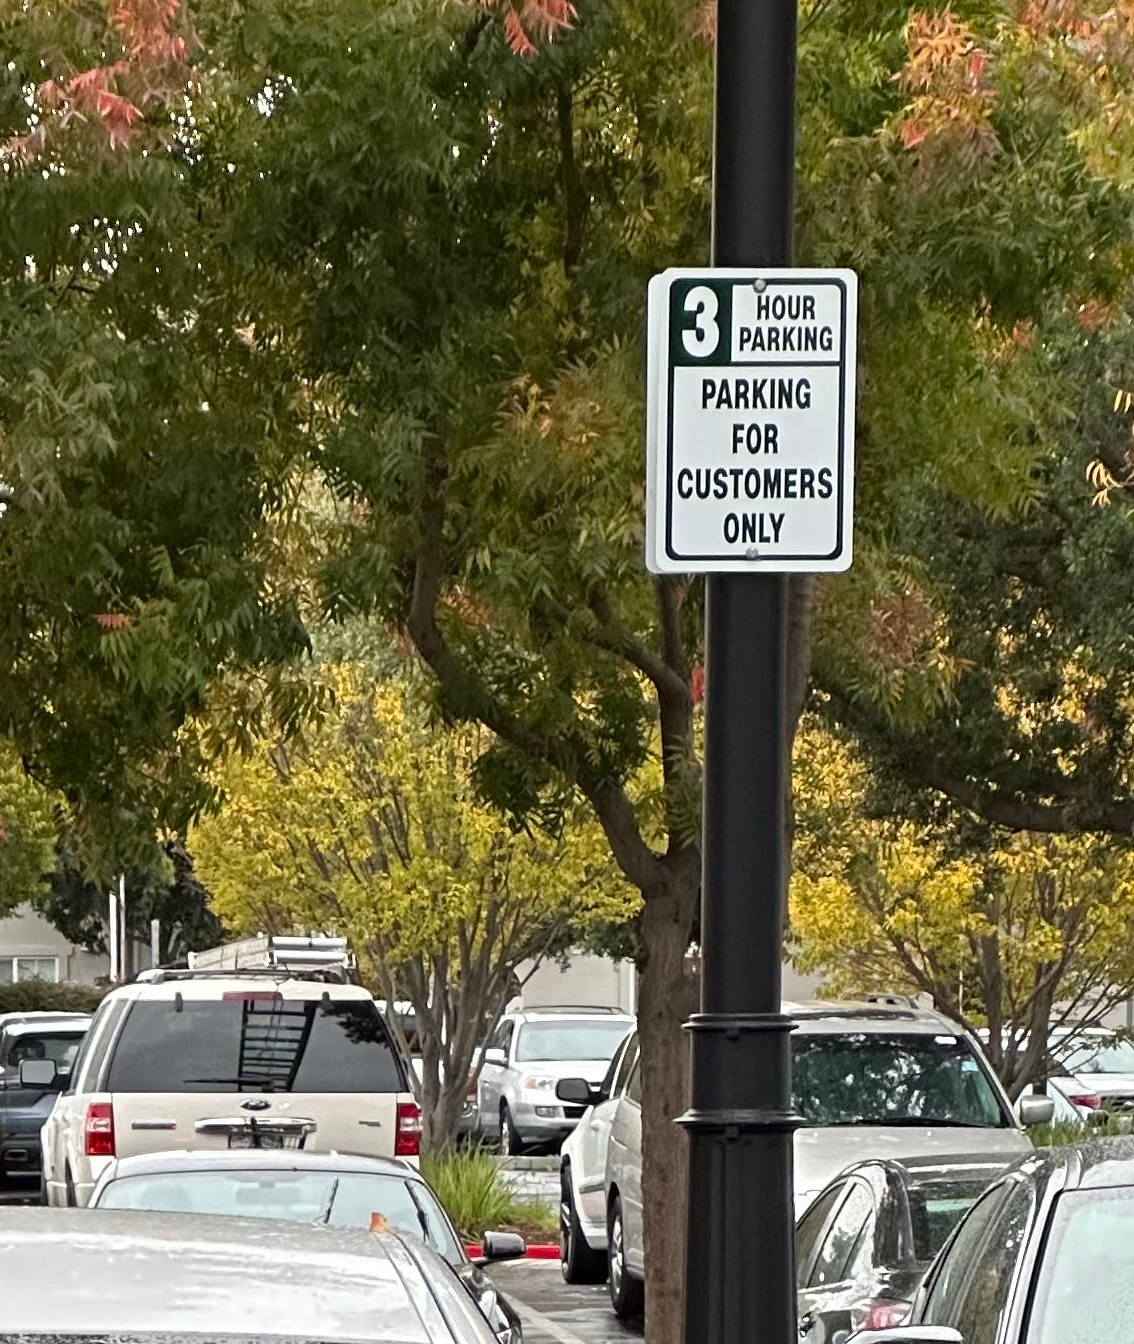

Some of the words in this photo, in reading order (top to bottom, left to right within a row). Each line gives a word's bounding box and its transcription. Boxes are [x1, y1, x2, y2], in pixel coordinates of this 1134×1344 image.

[682, 286, 720, 358] 3
[756, 295, 816, 321] HOUR
[739, 326, 833, 352] PARKING
[702, 378, 811, 409] PARKING
[732, 423, 779, 454] FOR
[677, 467, 833, 500] CUSTOMERS
[723, 512, 785, 544] ONLY
